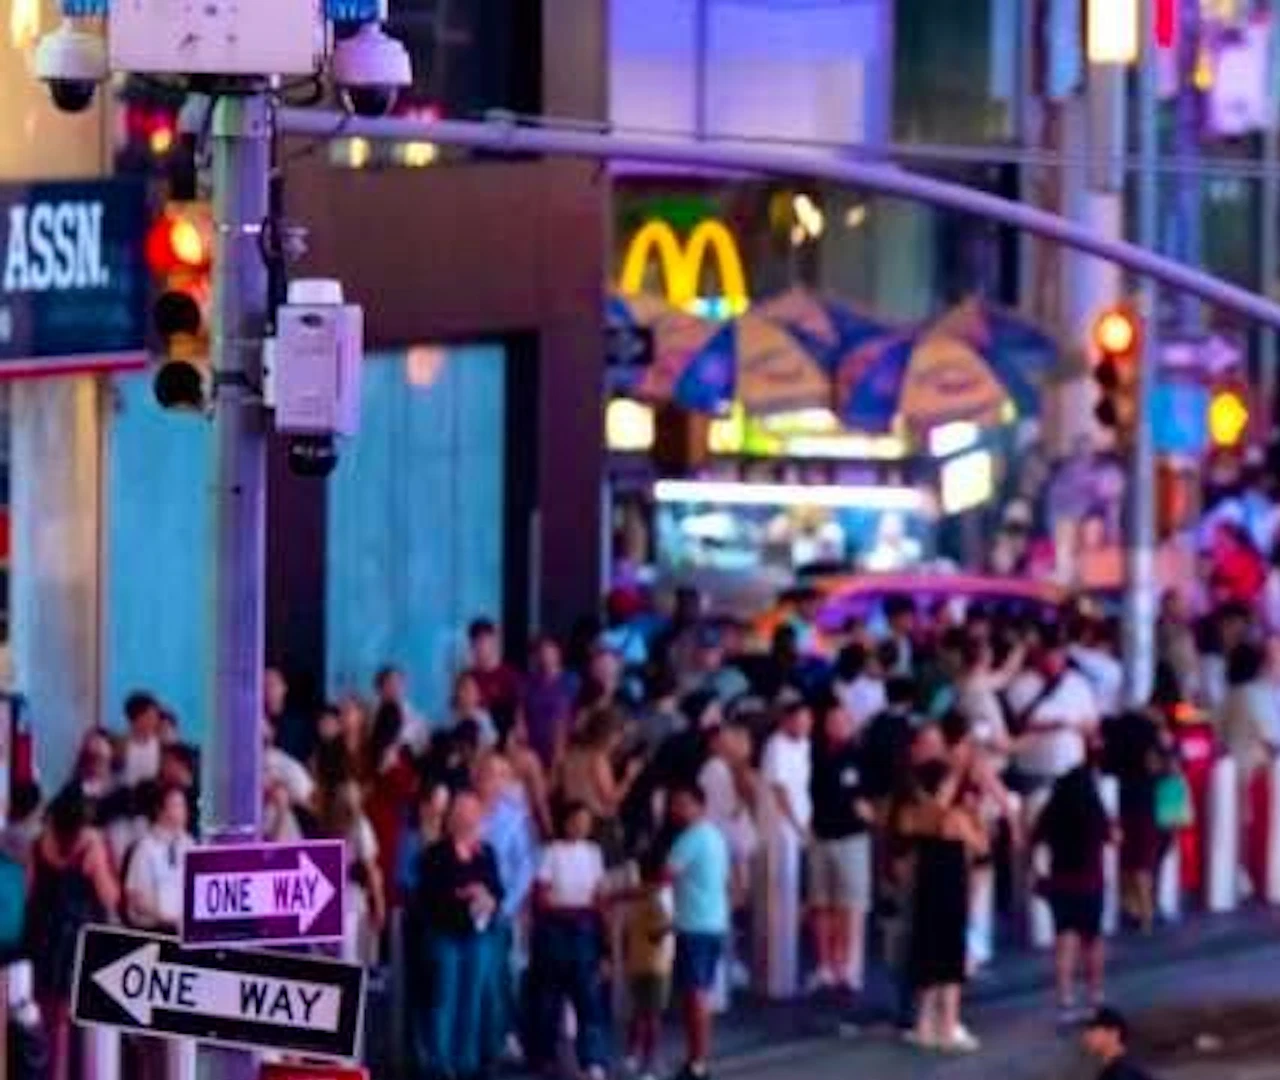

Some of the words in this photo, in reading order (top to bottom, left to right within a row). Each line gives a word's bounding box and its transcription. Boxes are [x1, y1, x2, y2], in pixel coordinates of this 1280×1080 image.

[4, 202, 110, 290] ASSN.
[205, 877, 253, 914] ONE
[272, 875, 319, 910] WAY
[121, 963, 198, 1007] ONE
[239, 980, 323, 1022] WAY
